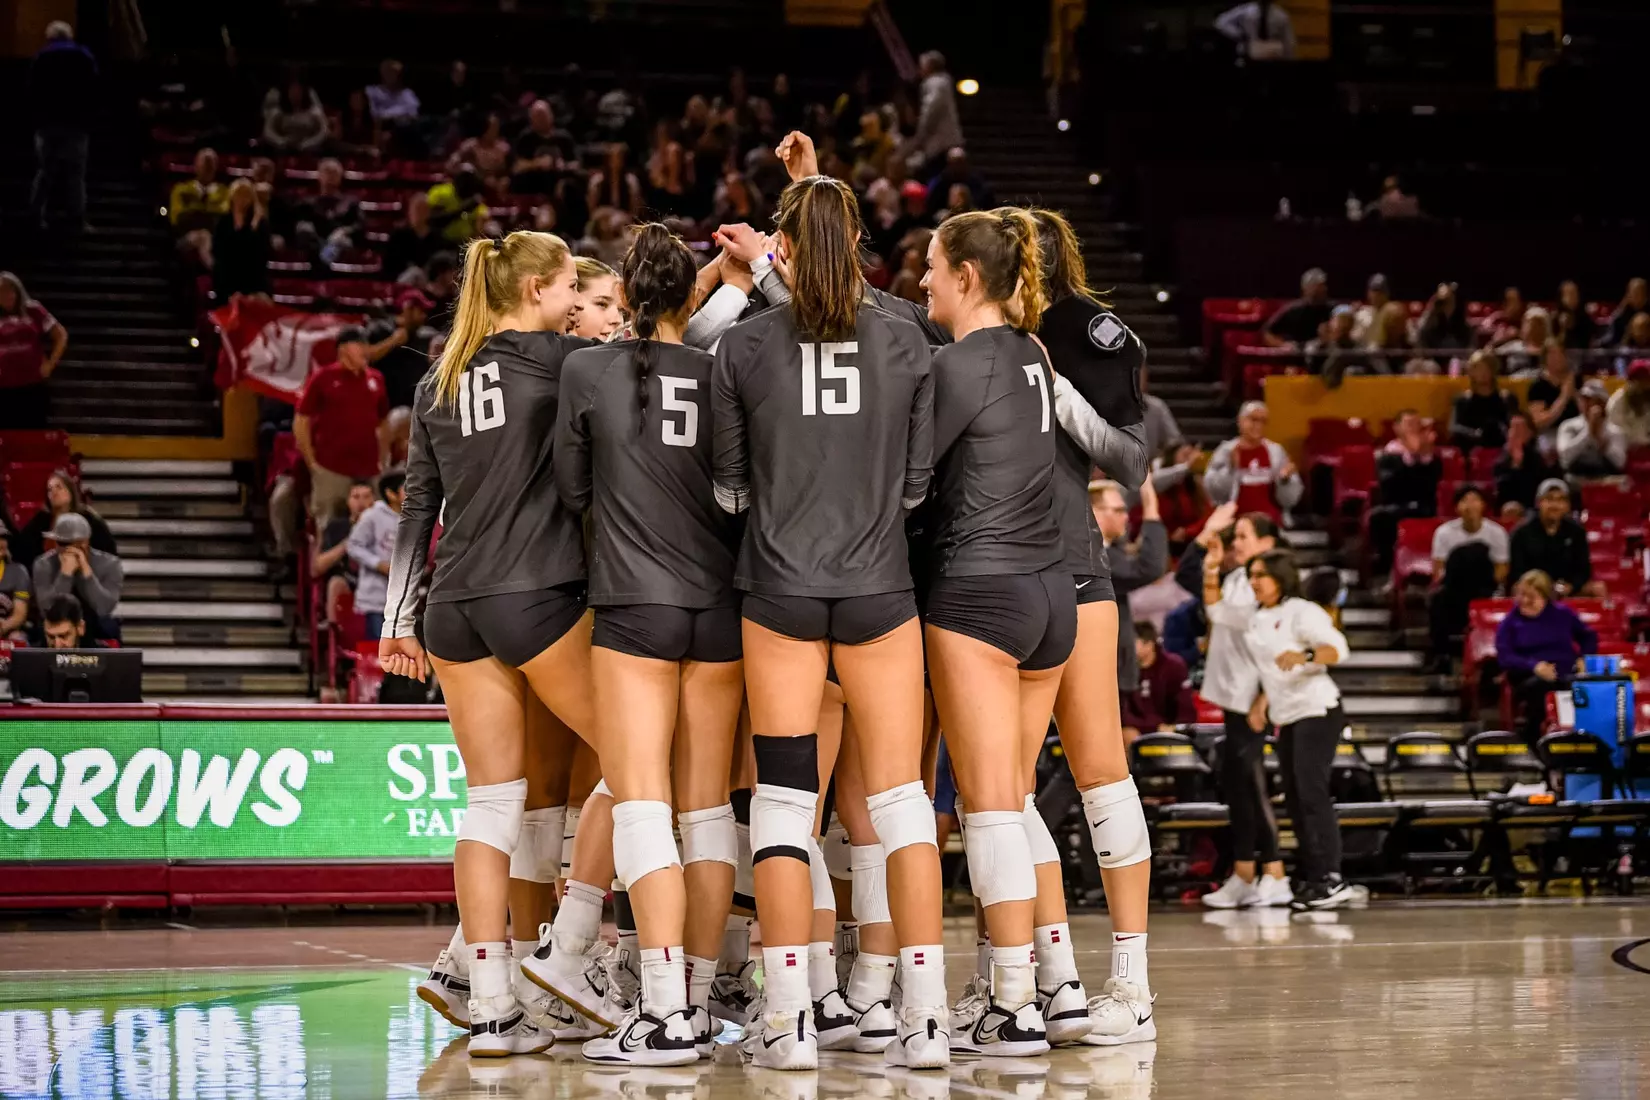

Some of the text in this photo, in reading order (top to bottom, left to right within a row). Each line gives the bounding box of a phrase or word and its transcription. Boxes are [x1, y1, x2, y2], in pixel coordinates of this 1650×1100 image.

[459, 361, 506, 437] 16
[657, 375, 698, 447] 5
[798, 341, 861, 415] 15
[1022, 362, 1050, 433] 7
